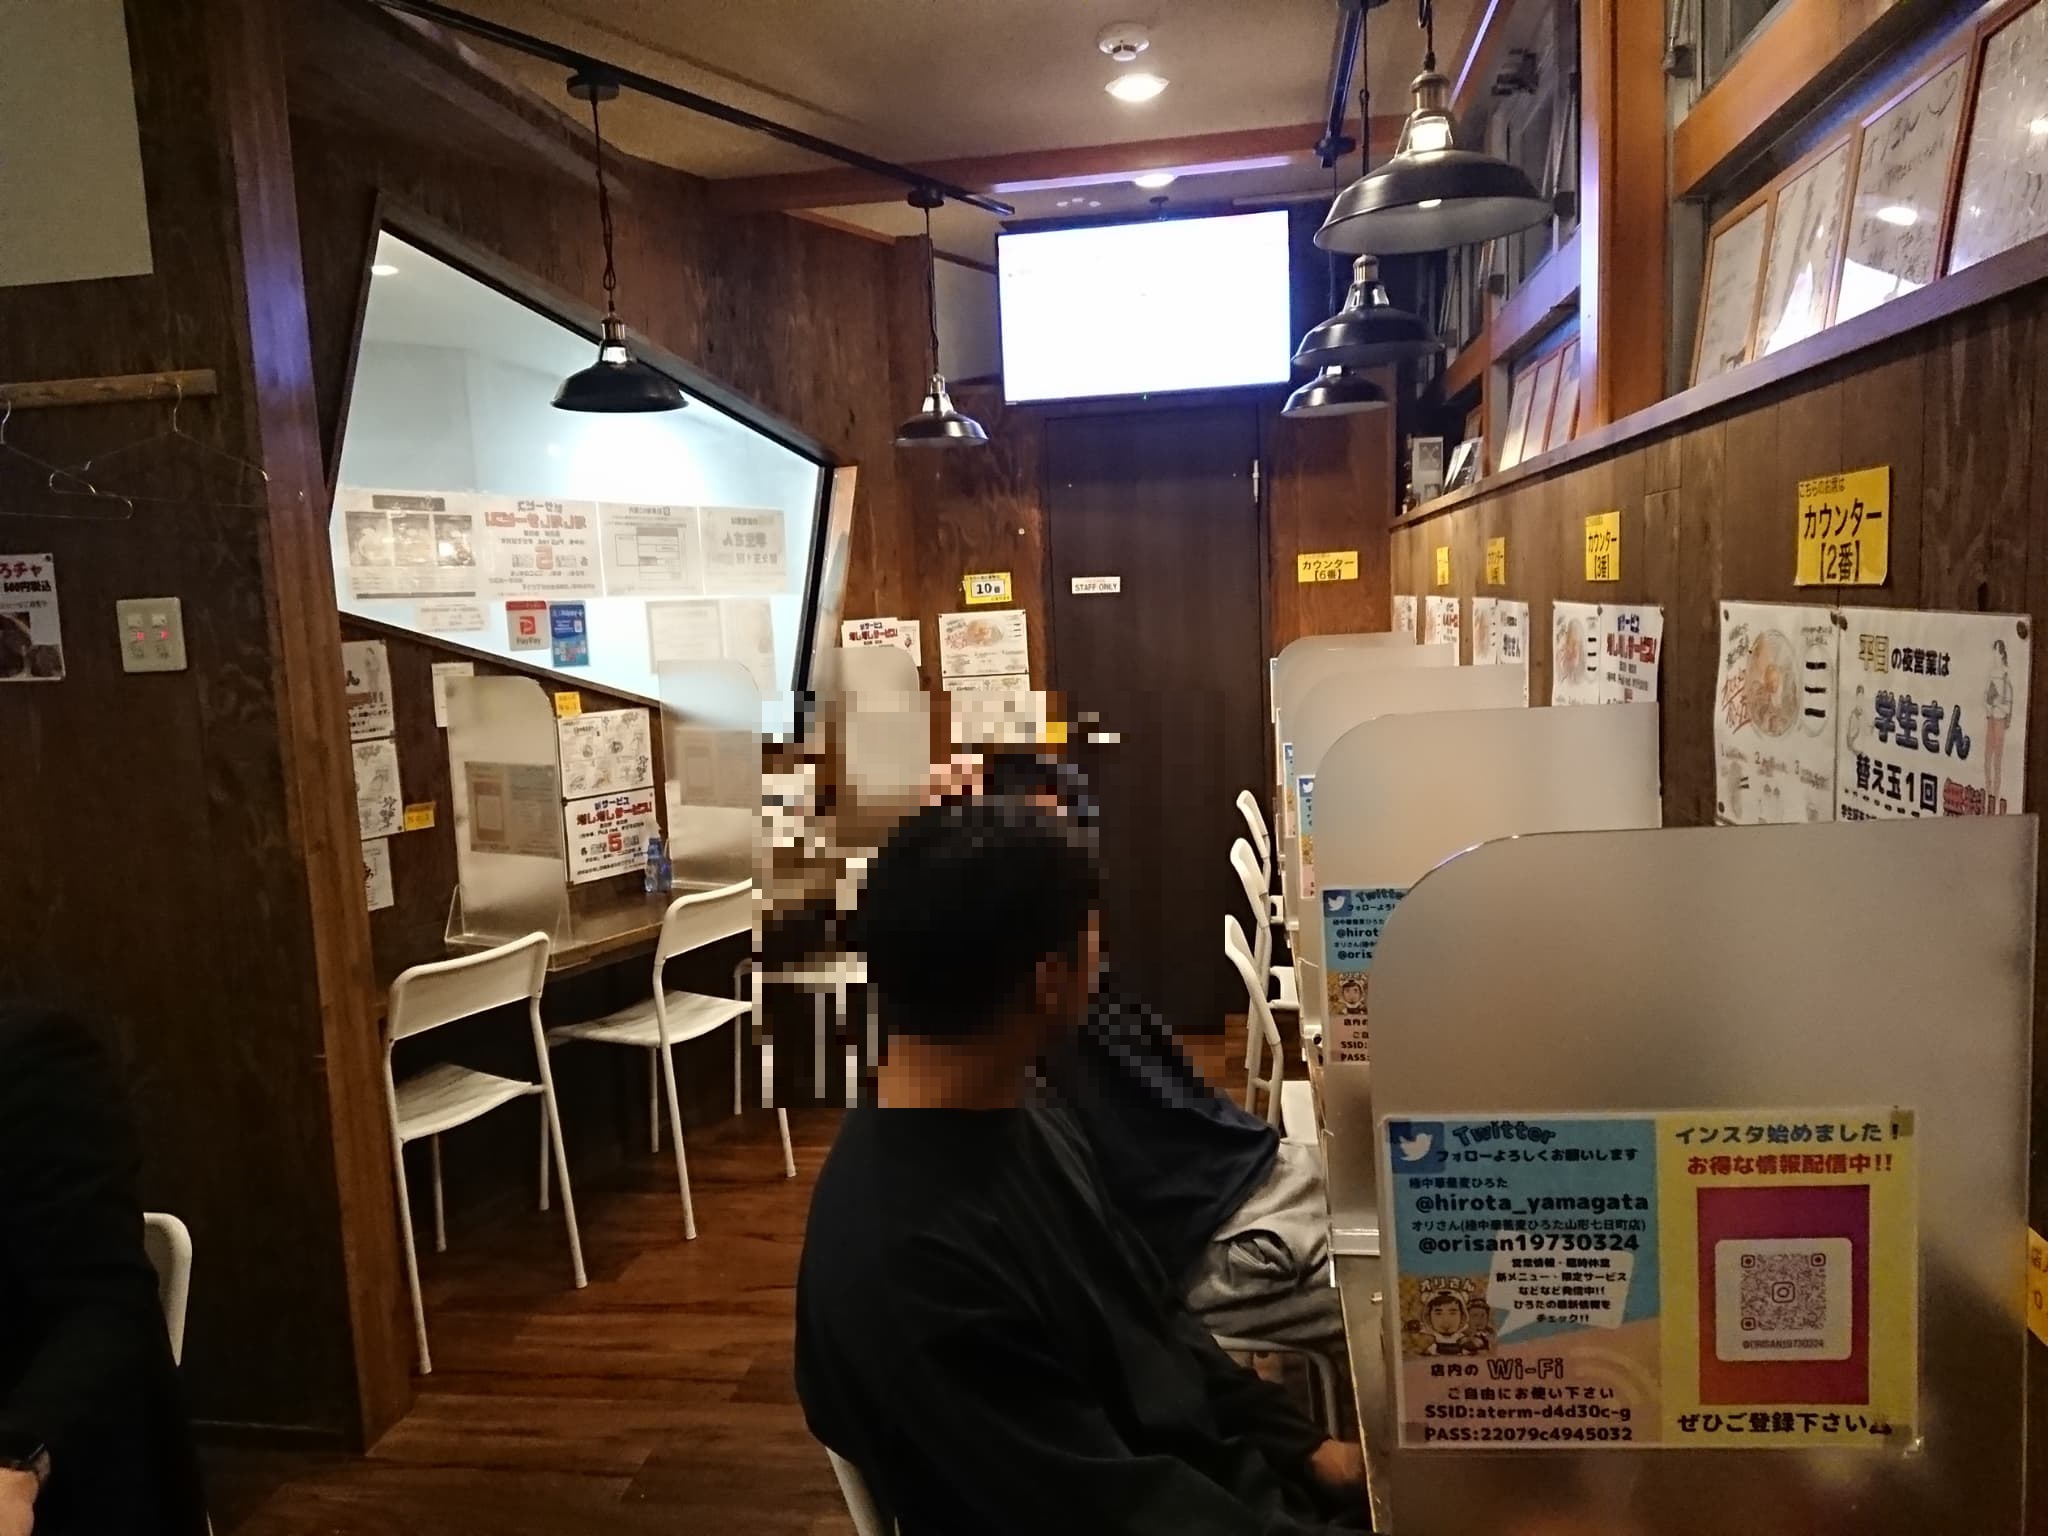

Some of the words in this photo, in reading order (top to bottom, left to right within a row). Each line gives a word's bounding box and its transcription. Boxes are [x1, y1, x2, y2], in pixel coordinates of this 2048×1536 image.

[1805, 498, 1882, 539] カウンター
[1303, 558, 1354, 570] カウンター
[1075, 583, 1096, 592] STAFF
[1099, 583, 1118, 591] ONLY
[516, 637, 541, 645] PayPay
[1859, 634, 1950, 677] 平日の夜営業は
[1874, 690, 1971, 760] 学生さん
[1856, 753, 1938, 814] 替え玉1回
[1336, 927, 1379, 939] @hirot
[1452, 1121, 1556, 1147] Twitter
[1437, 1149, 1638, 1163] フォローよろしくお願いします
[1688, 1154, 1893, 1175] お得な情報配信中!!
[1416, 1193, 1649, 1214] @hirota_yamagata
[1418, 1233, 1640, 1254] @orisan19730324
[1419, 1277, 1476, 1292] オリさん
[1496, 1272, 1627, 1282] 新メニュー・限定サービス
[1431, 1364, 1479, 1376] 店内の
[1487, 1358, 1564, 1380] Wi-Fi
[1448, 1386, 1614, 1400] ご自由にお使い下さい
[1425, 1404, 1632, 1421] SSID:aterm-d4d30c-g
[1677, 1412, 1867, 1434] ぜひご登録下さい
[1424, 1427, 1633, 1442] PASS:22079c4945032
